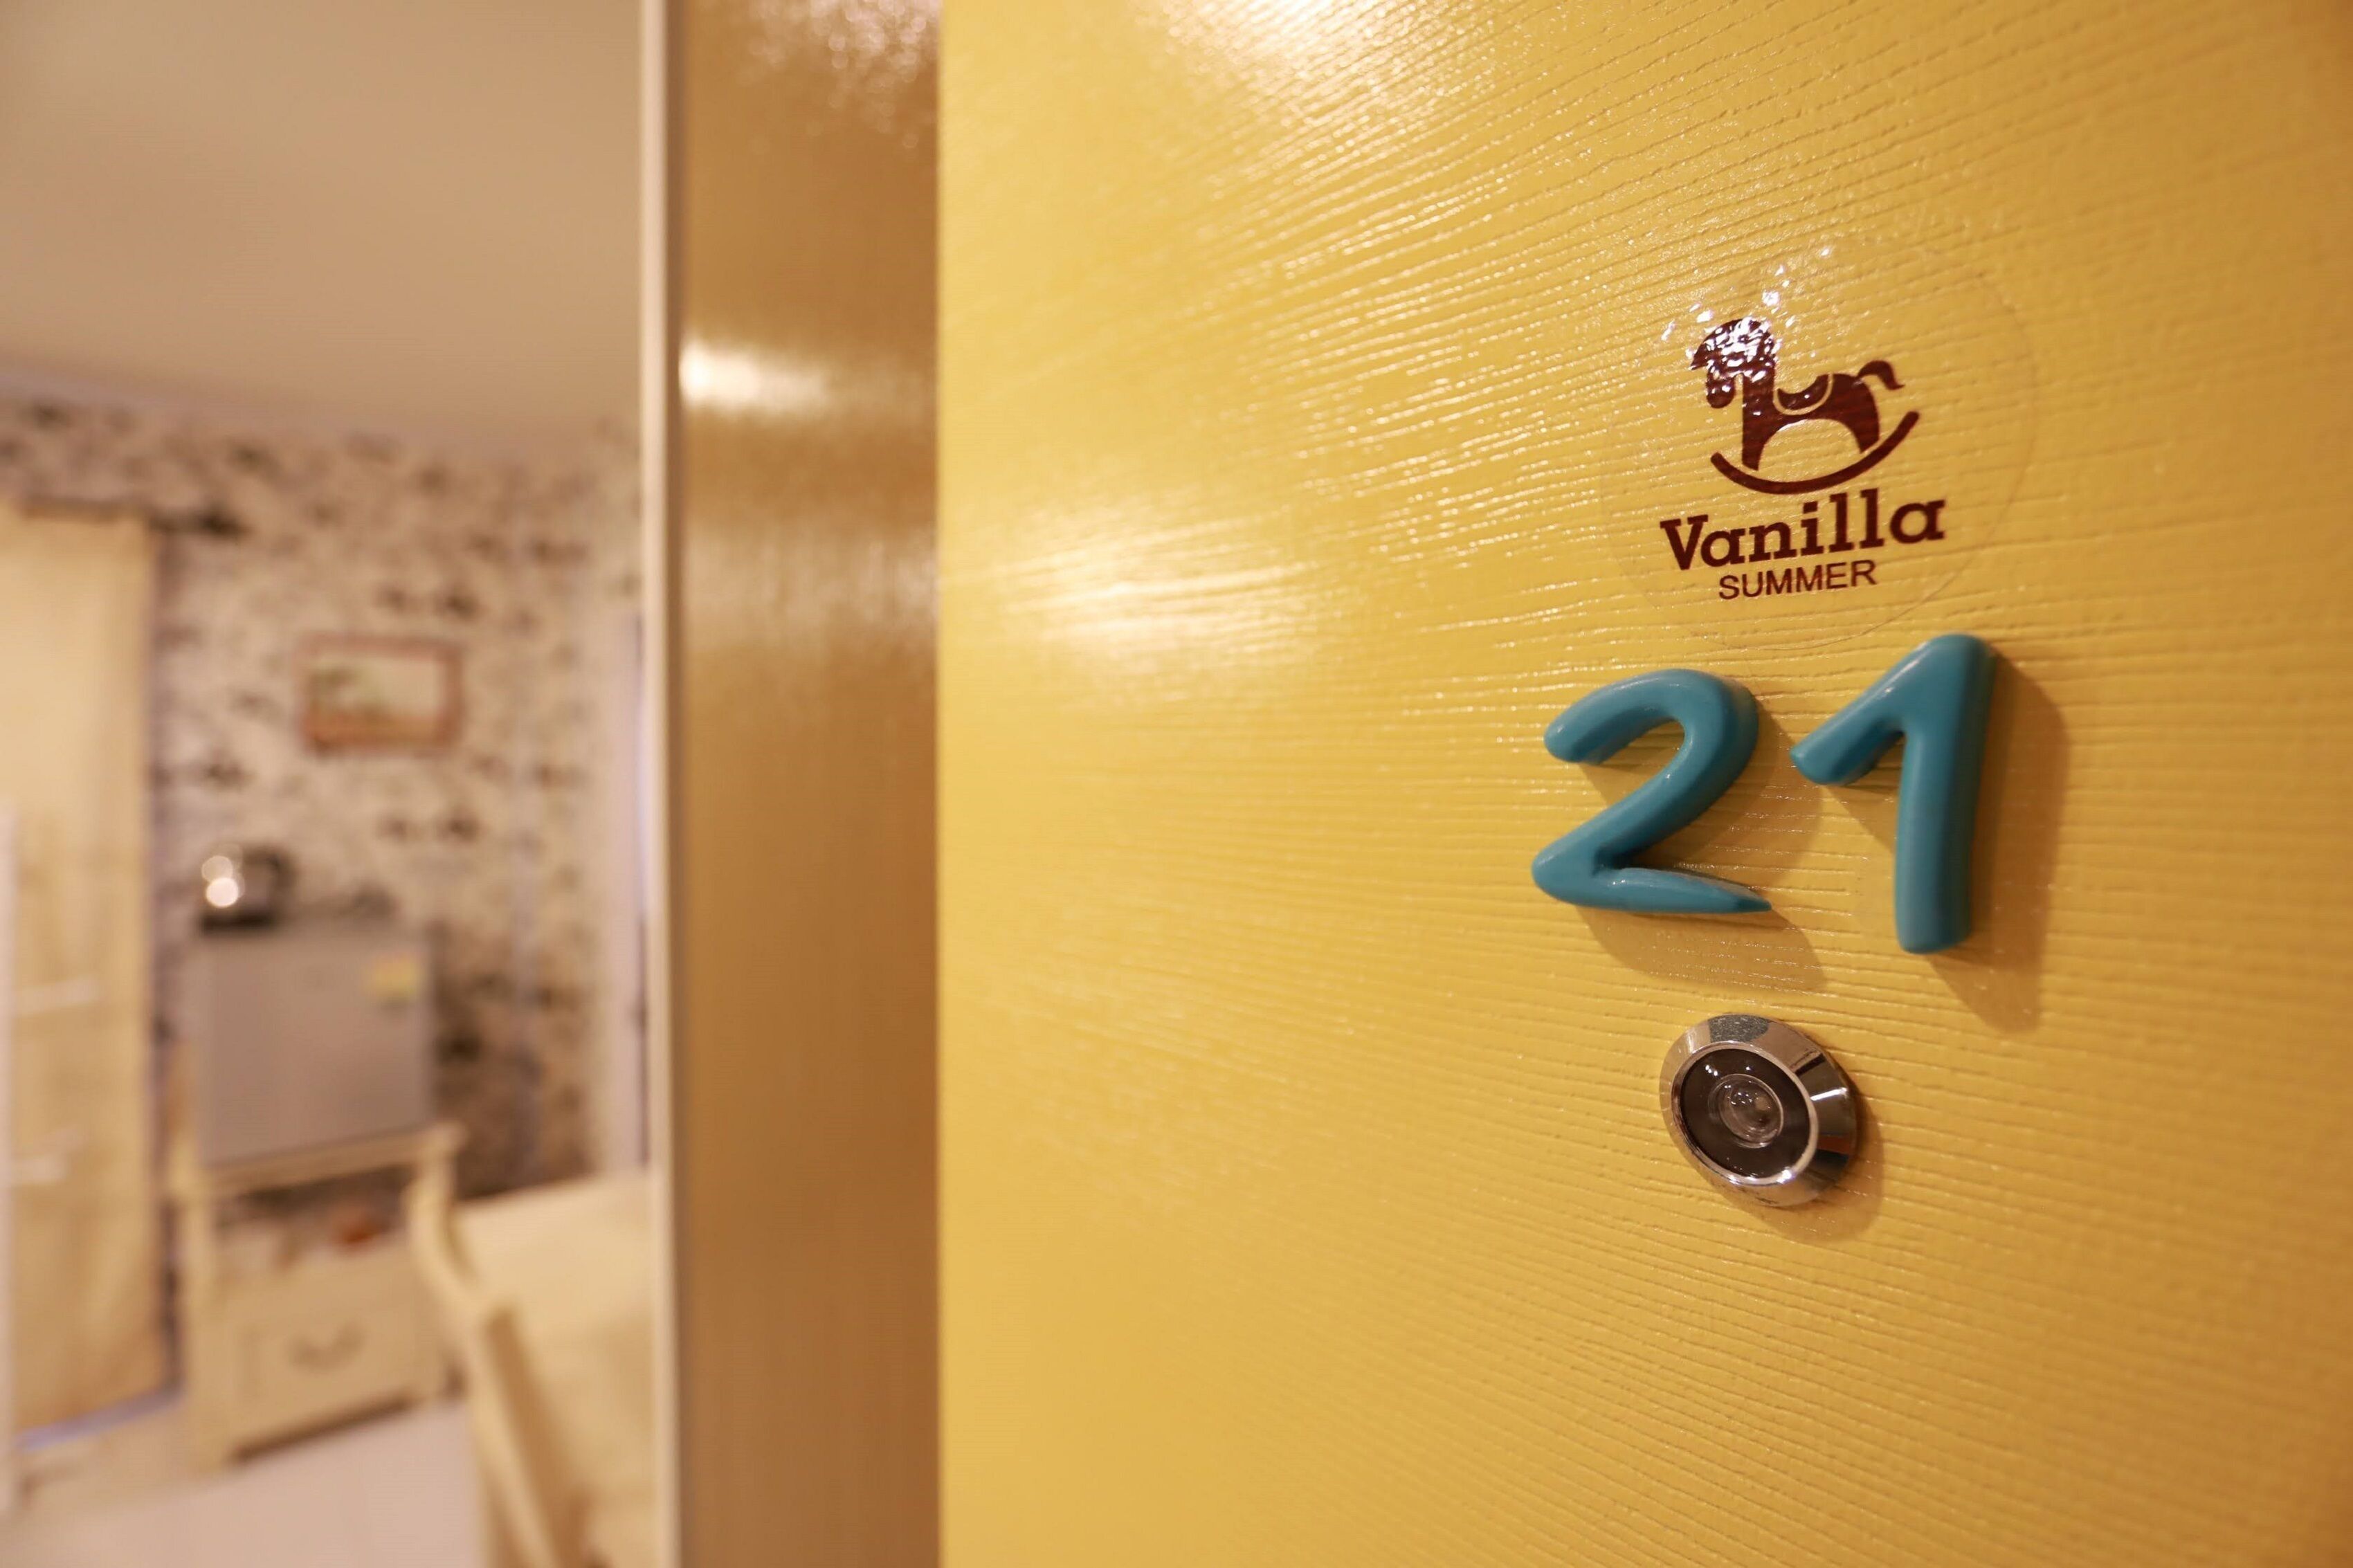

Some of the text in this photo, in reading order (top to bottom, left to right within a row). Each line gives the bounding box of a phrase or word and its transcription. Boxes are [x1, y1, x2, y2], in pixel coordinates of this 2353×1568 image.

[1659, 487, 1946, 572] Vanilla
[1718, 559, 1877, 601] SUMMER
[1532, 632, 1996, 955] 21
